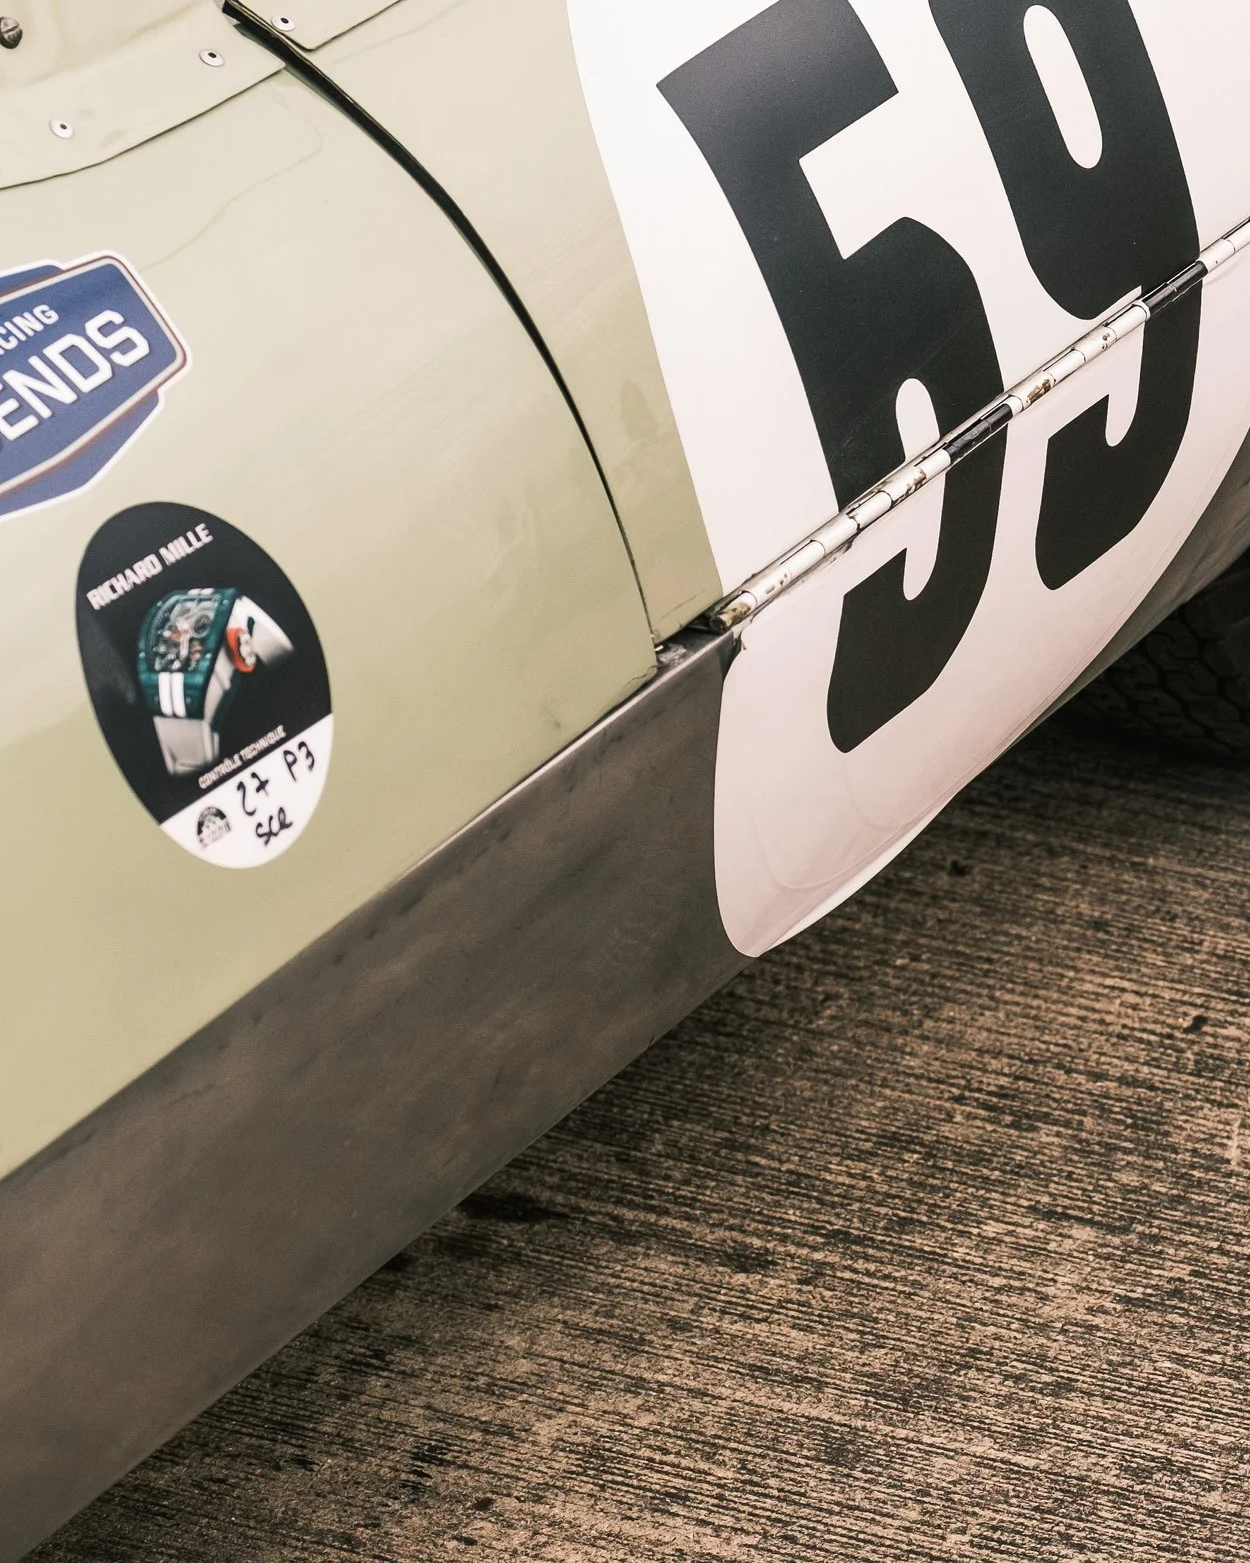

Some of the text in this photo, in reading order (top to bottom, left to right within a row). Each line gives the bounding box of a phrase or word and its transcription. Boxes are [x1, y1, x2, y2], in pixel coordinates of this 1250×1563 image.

[0, 304, 60, 355] CING
[86, 522, 213, 611] RICHARD MILLE
